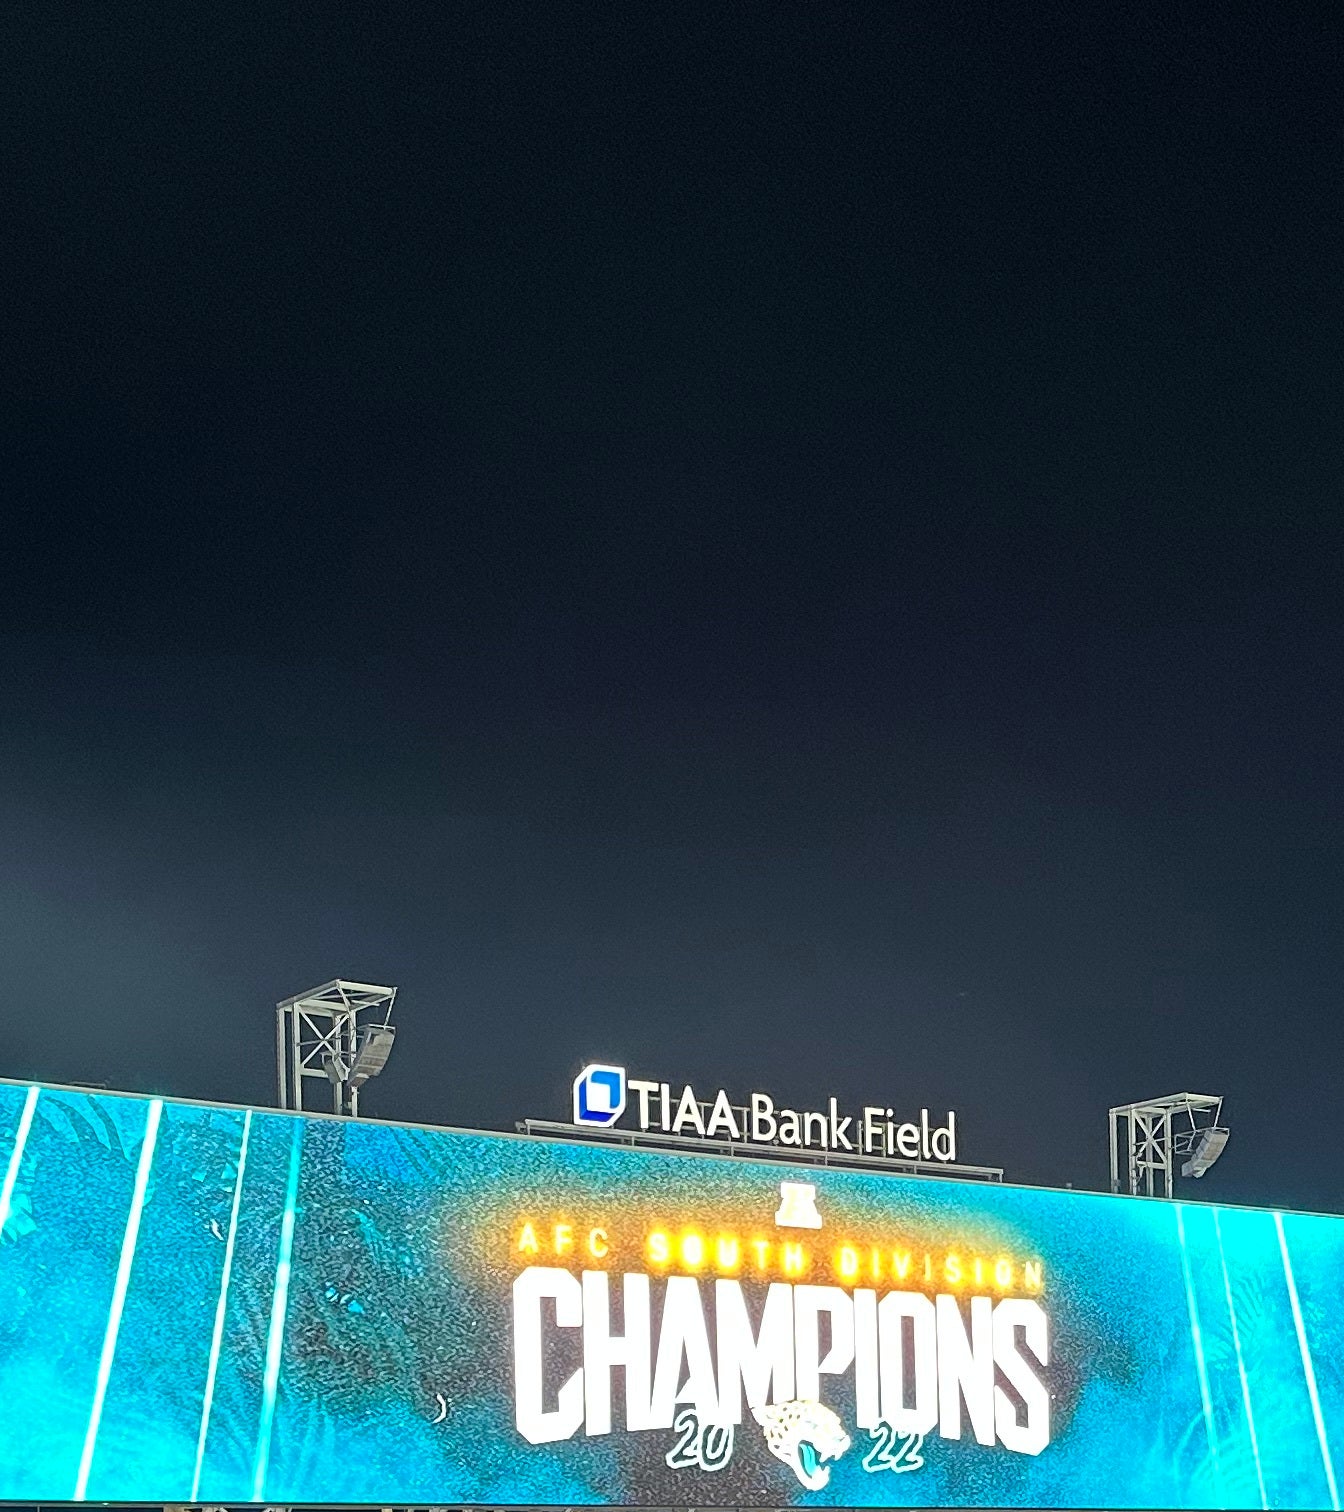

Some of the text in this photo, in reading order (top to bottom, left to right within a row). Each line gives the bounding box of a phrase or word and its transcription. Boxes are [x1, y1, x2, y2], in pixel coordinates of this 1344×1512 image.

[628, 1080, 956, 1161] TIAA Bank Field
[517, 1222, 1043, 1288] AFC SOUTH DIVISION
[513, 1265, 1049, 1456] CHAMPIONS
[666, 1408, 924, 1473] 20 22
